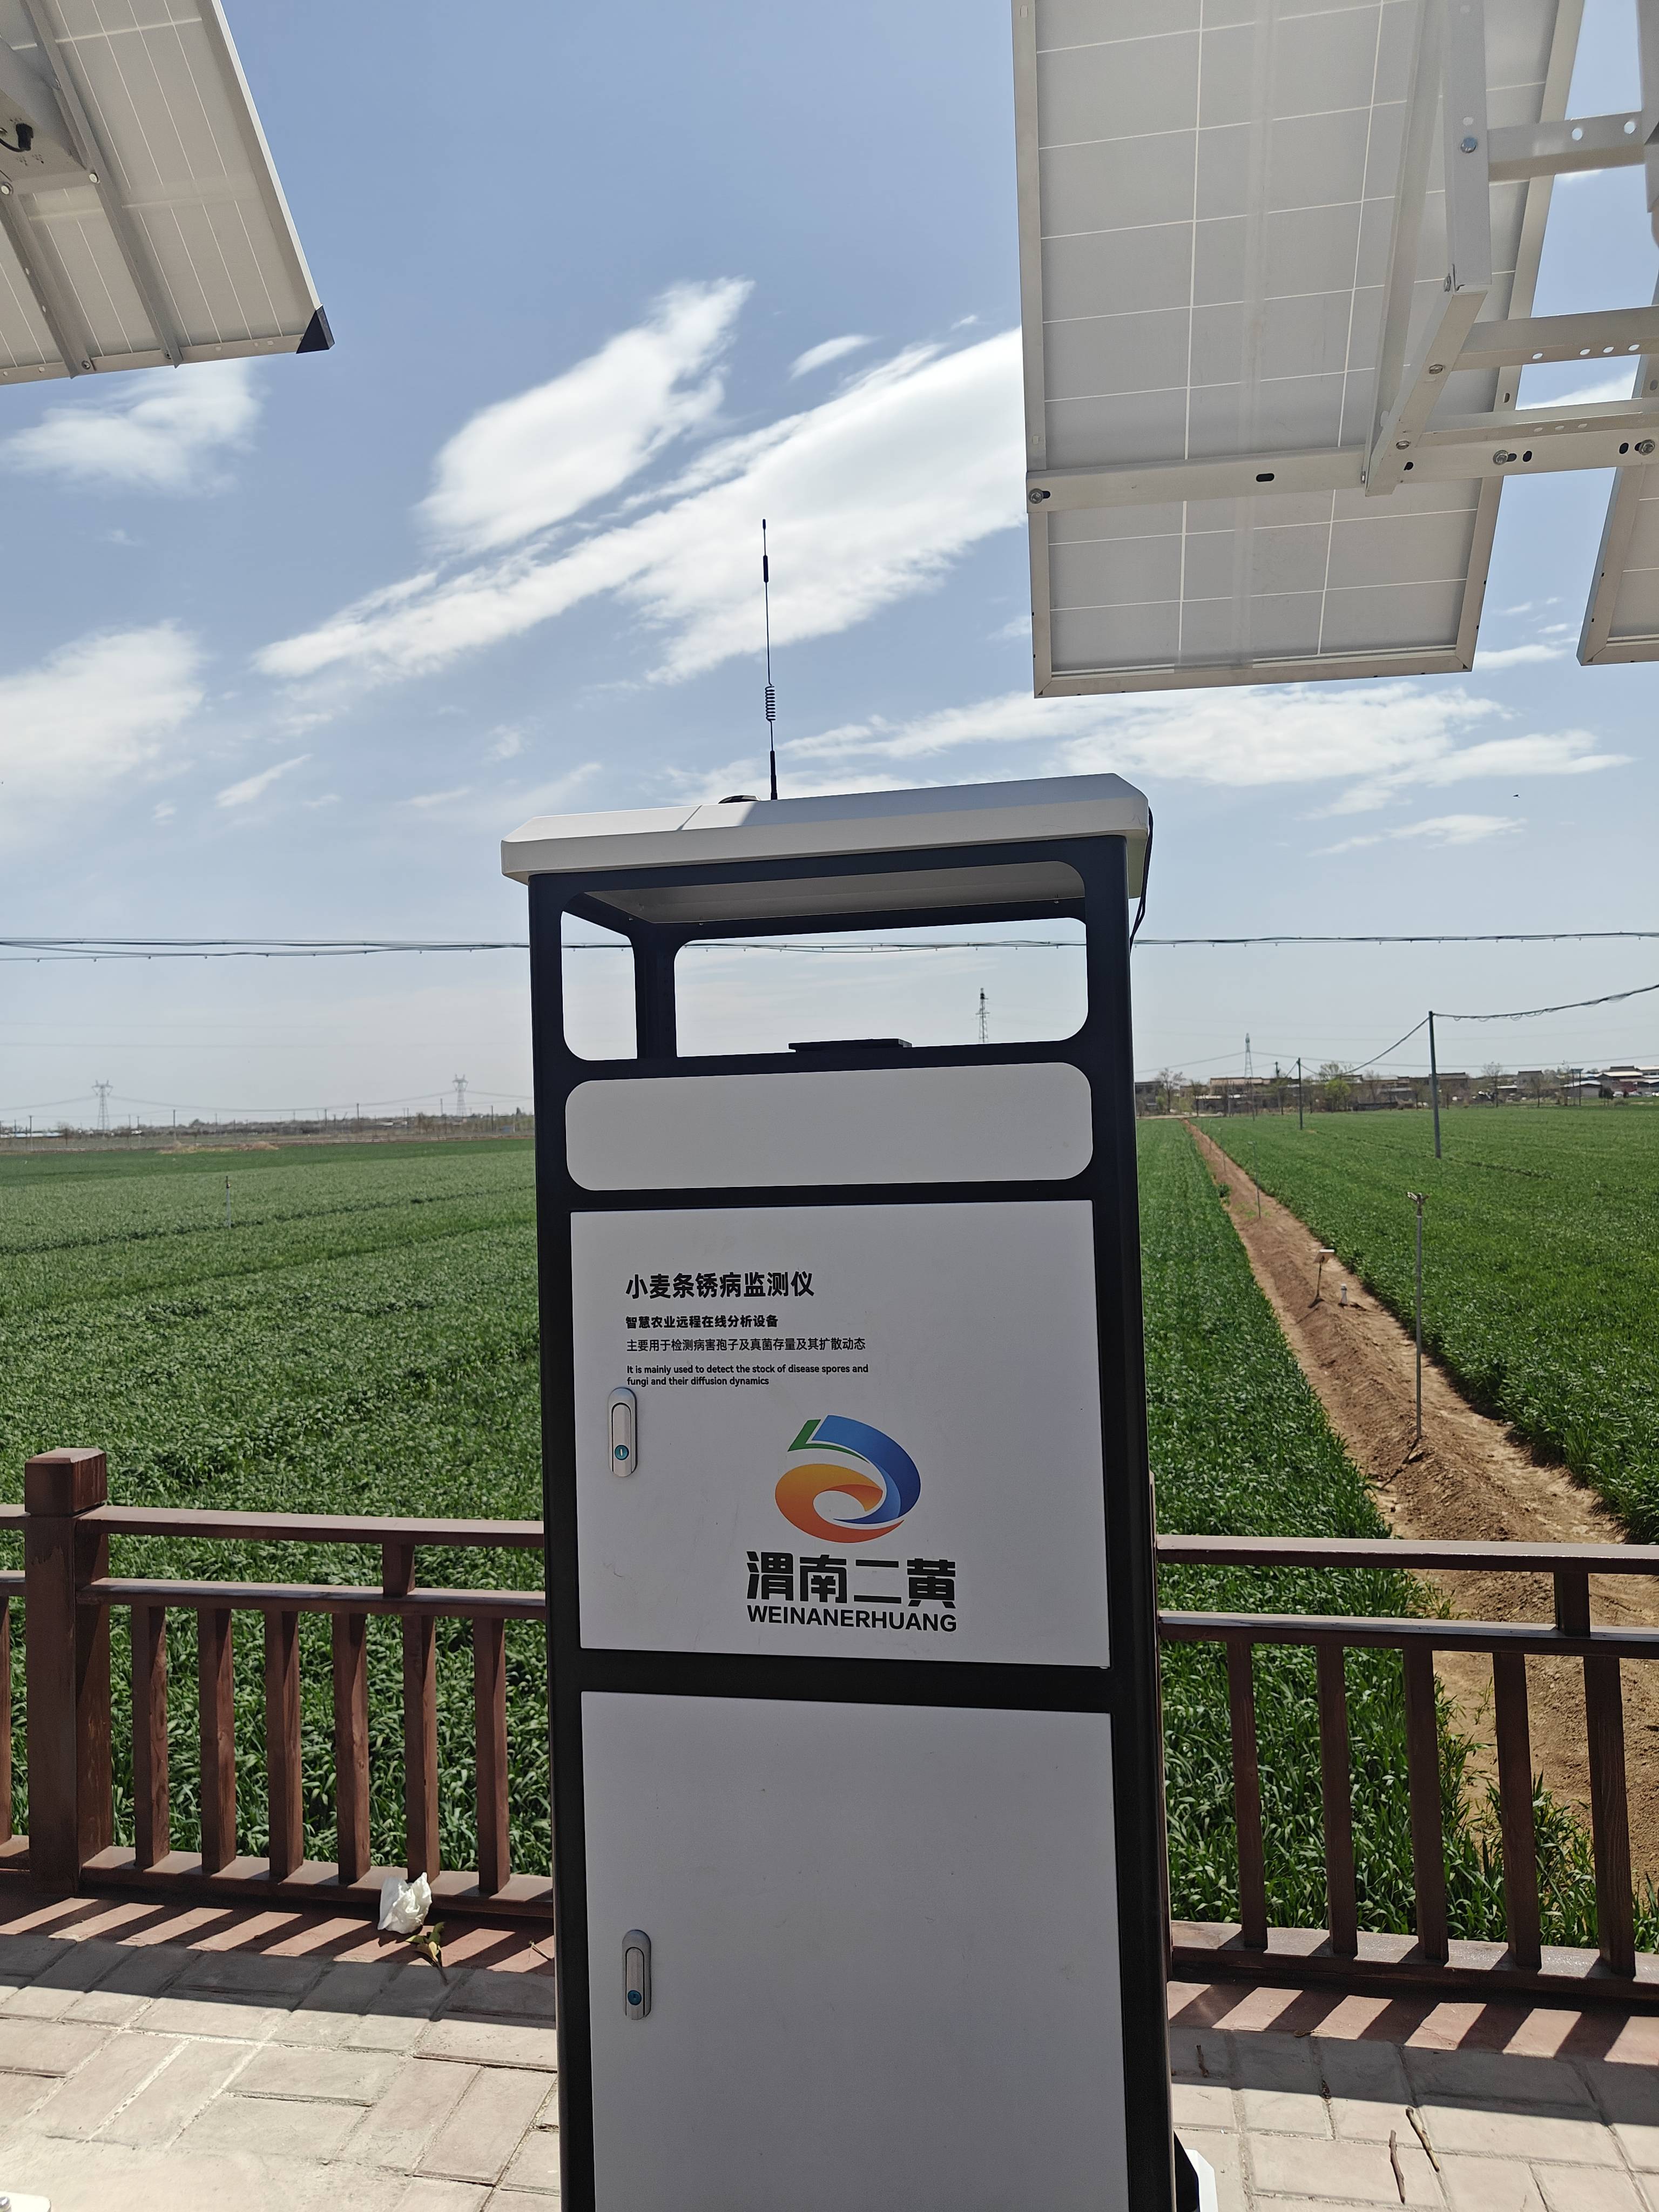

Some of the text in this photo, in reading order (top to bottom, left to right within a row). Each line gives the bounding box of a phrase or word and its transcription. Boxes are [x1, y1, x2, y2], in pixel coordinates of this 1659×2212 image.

[625, 1271, 814, 1299] 小麦条锈病监测仪
[625, 1314, 779, 1329] 智慧农业远程在线分析设备
[626, 1337, 866, 1352] 主要用于检测病害孢子及真菌存量及其扩散动态
[627, 1365, 633, 1373] It
[636, 1365, 642, 1373] is
[644, 1365, 671, 1375] mainly
[673, 1365, 693, 1373] used
[706, 1365, 734, 1373] detect
[736, 1365, 750, 1373] the
[752, 1364, 775, 1373] stock
[777, 1364, 786, 1373] of
[788, 1364, 820, 1373] disease
[821, 1365, 850, 1375] spores
[852, 1364, 868, 1373] and
[627, 1376, 769, 1387] fungi and their diffusion dynamics
[746, 1550, 956, 1609] 渭南二黄
[747, 1604, 957, 1632] WEINANERHUANG
